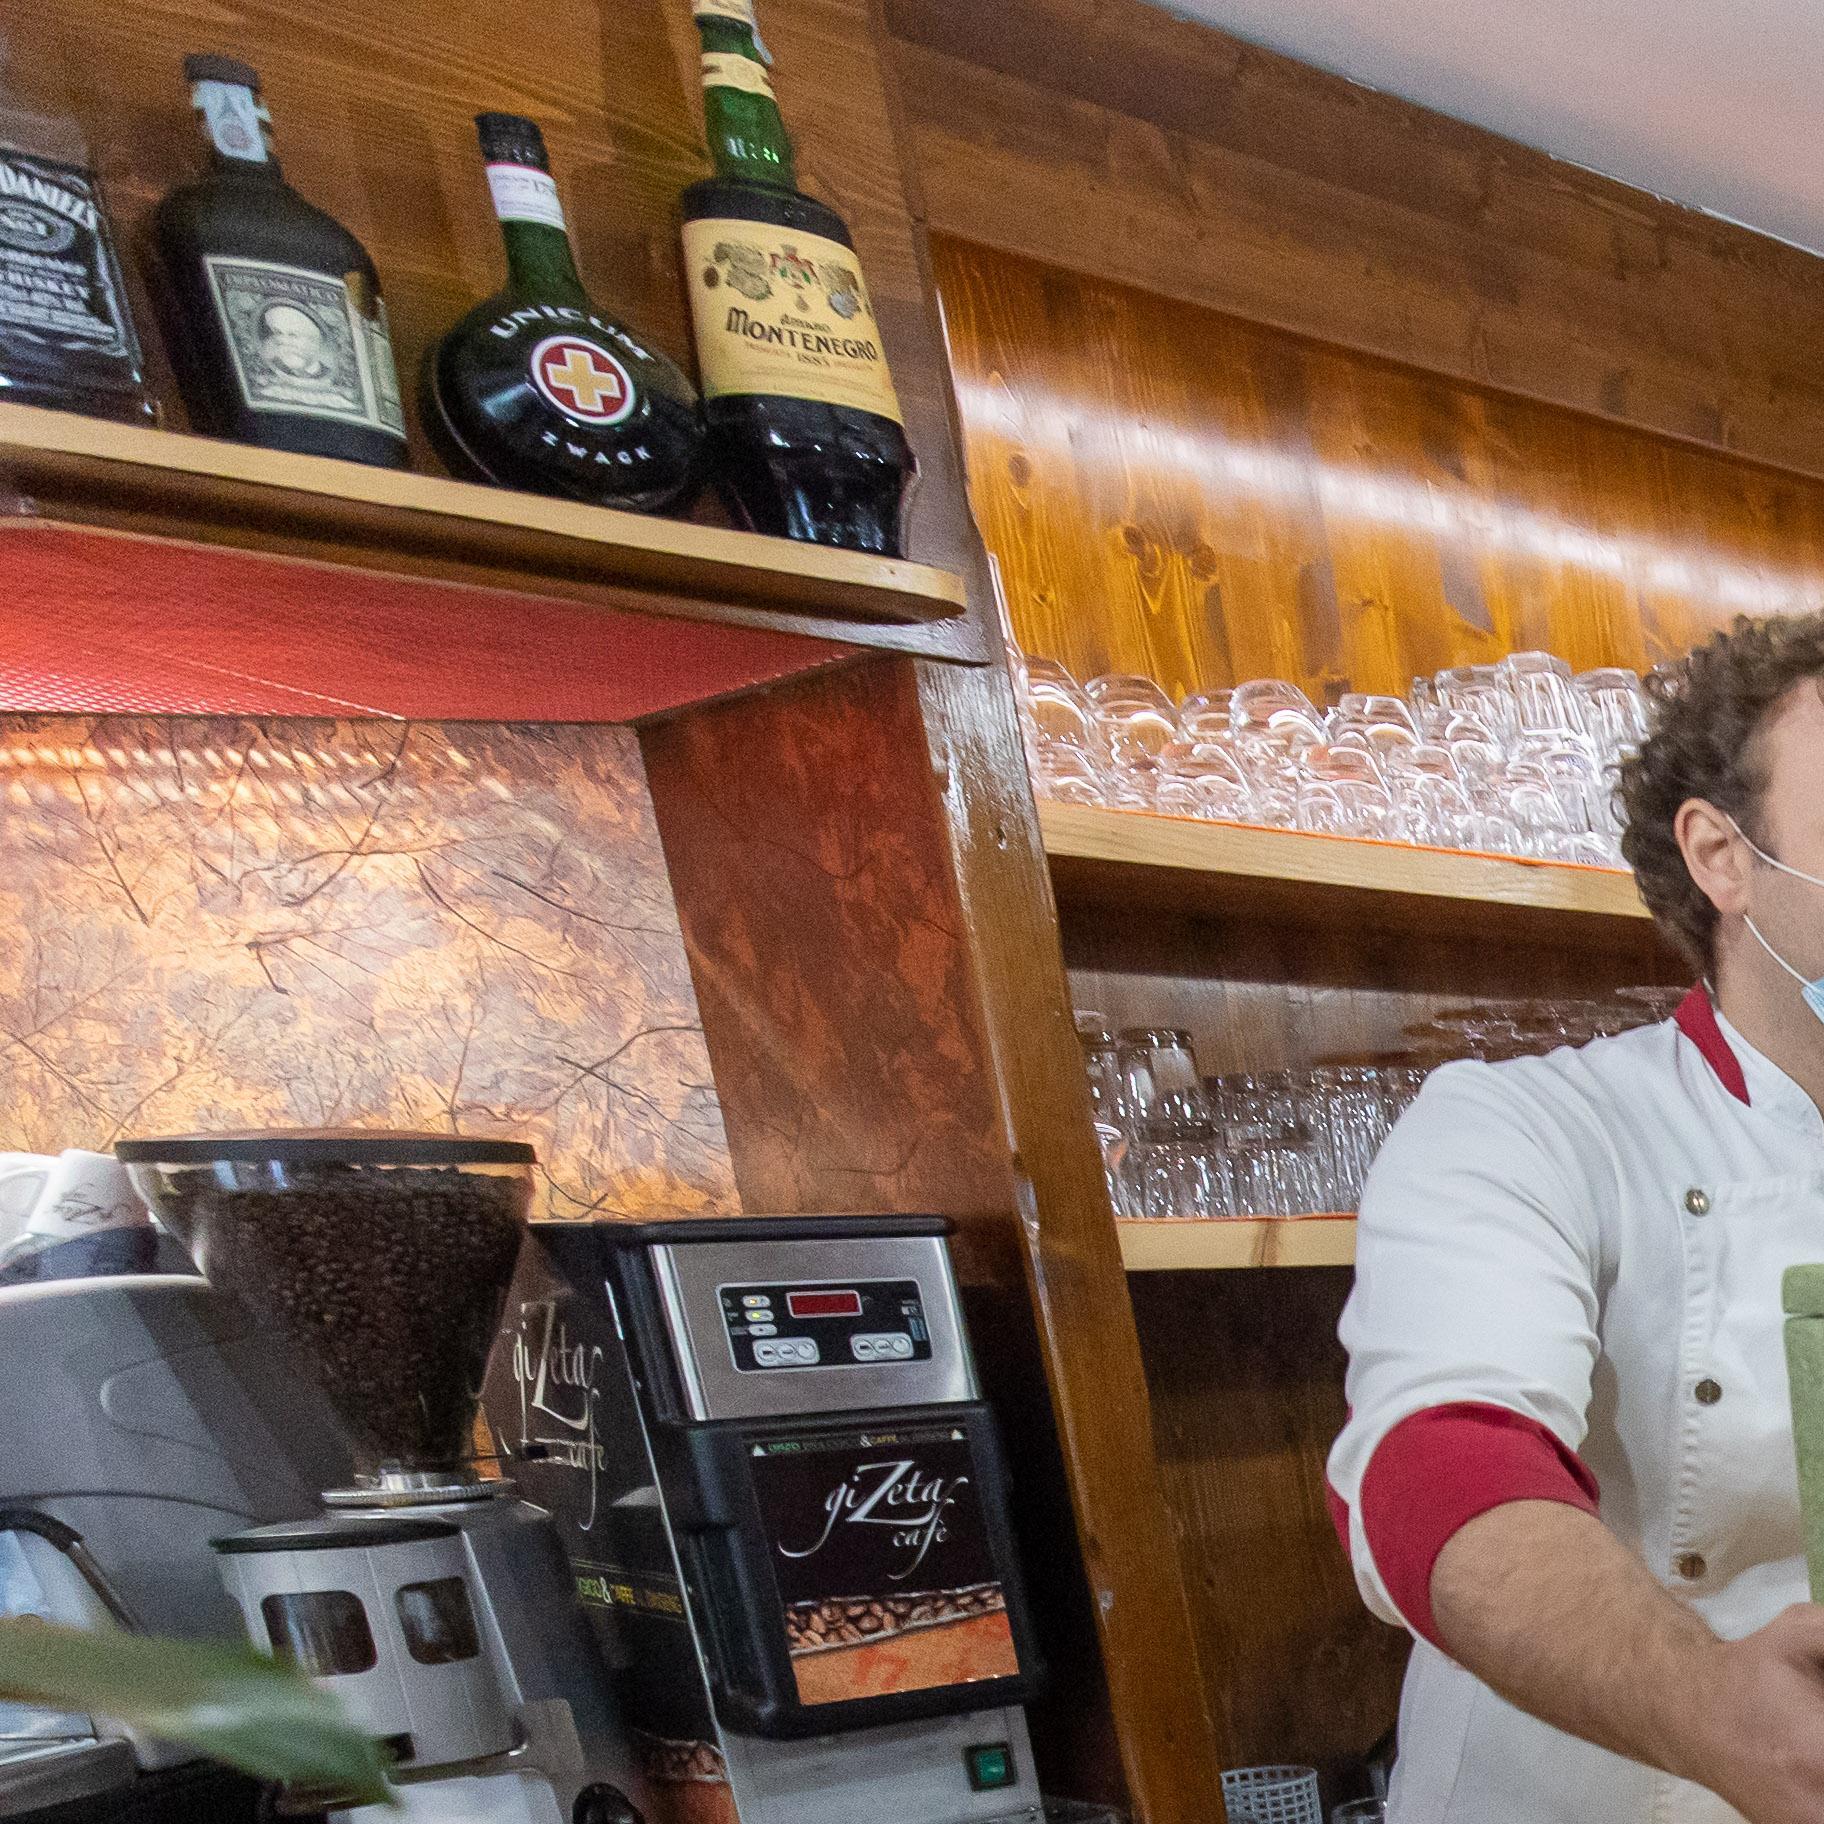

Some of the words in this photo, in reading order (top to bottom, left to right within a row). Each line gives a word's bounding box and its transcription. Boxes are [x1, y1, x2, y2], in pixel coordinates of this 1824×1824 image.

[490, 304, 657, 362] UNICUM
[541, 430, 653, 465] ZWACK
[778, 1459, 969, 1557] giZeta
